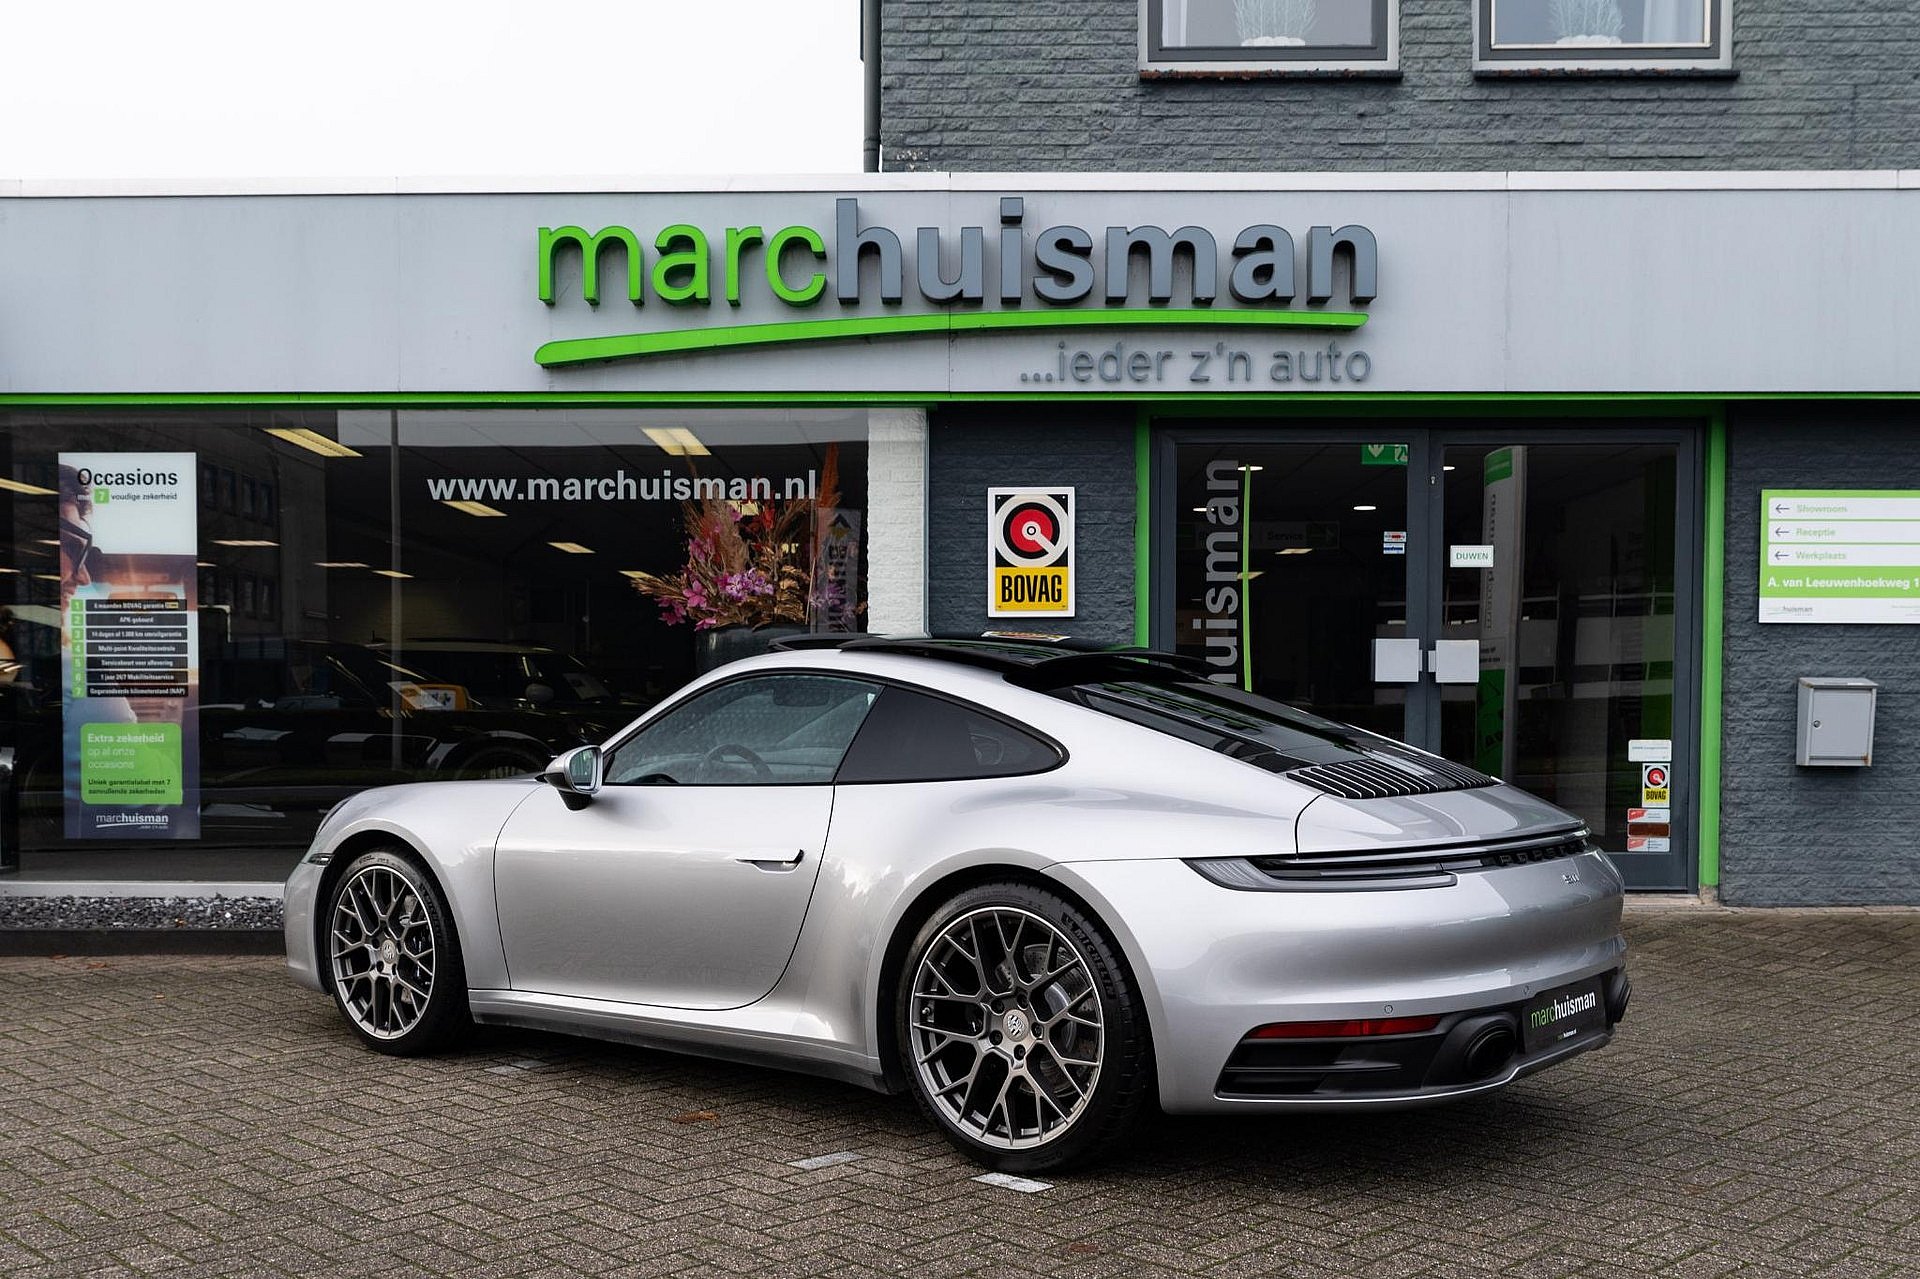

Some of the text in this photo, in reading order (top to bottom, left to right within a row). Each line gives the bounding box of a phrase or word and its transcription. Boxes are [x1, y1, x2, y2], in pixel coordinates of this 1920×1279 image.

[538, 197, 1378, 306] marchuisman
[1190, 342, 1252, 383] z'n
[1269, 342, 1372, 383] auto
[77, 468, 178, 485] Occasions
[427, 470, 816, 500] www.marchuisman.nl
[111, 493, 140, 501] voudige
[1797, 504, 1848, 513] Showroom
[1796, 528, 1836, 537] Receptie
[1456, 552, 1489, 560] DUWEN
[1796, 551, 1847, 561] Werkplaats
[1001, 574, 1063, 603] BOVAG
[1767, 577, 1779, 588] A.
[1783, 579, 1802, 588] van
[1806, 577, 1910, 590] Leeuwenhoekweg
[88, 733, 164, 743] Extra zekerheid
[88, 747, 135, 758] op al onze
[88, 761, 135, 769] occasions
[109, 779, 151, 787] garantielabel
[1645, 789, 1667, 800] BOVAG
[96, 813, 169, 823] marchuisman
[1530, 991, 1596, 1029] marchuisman
